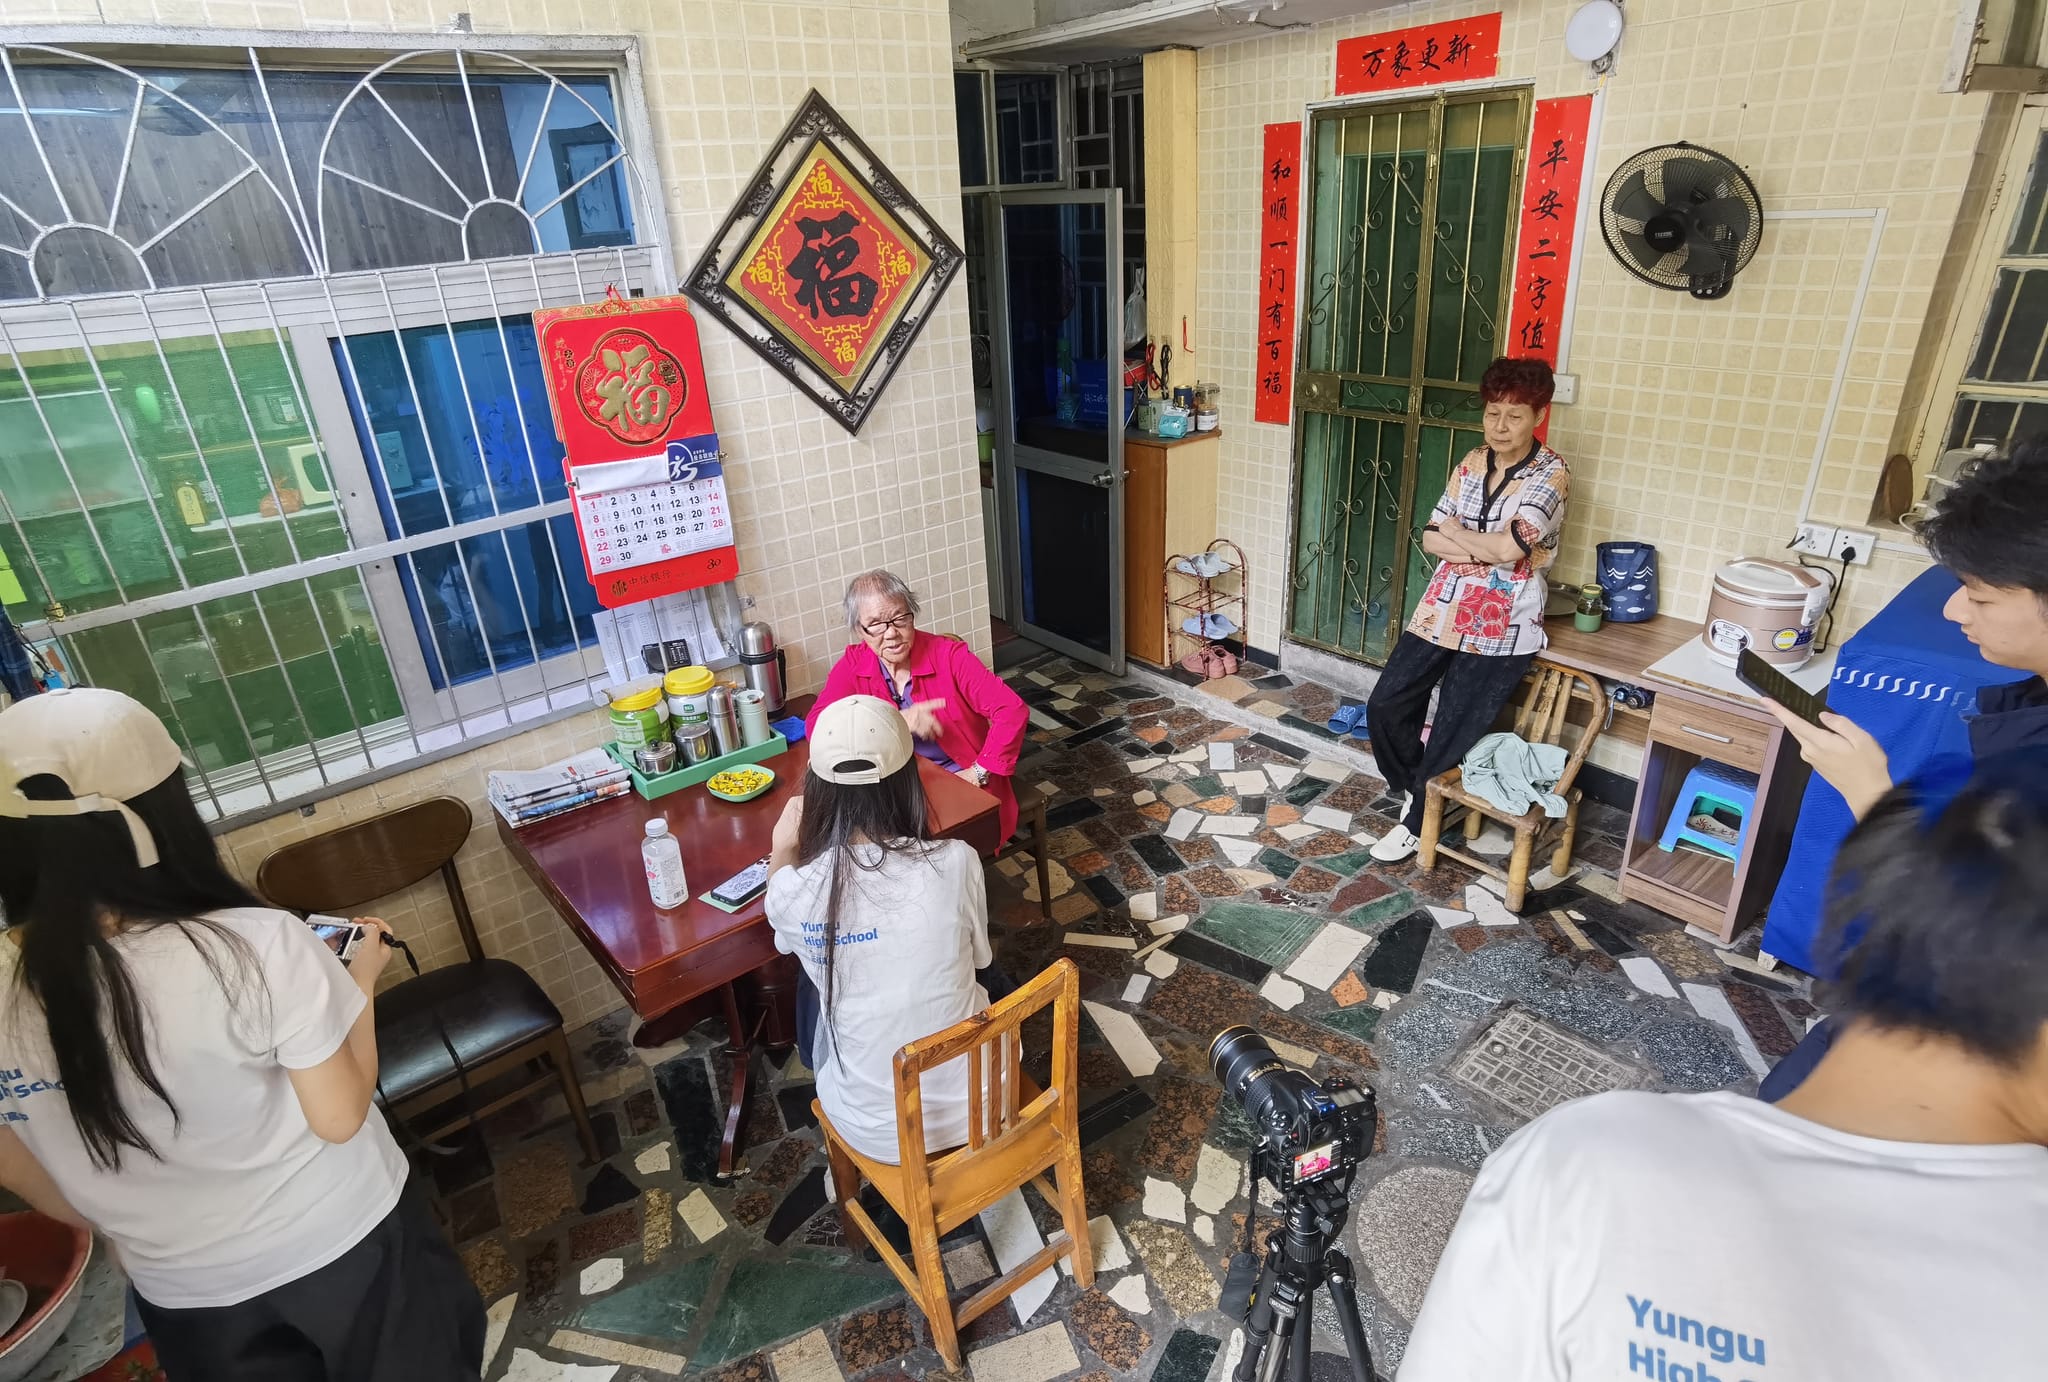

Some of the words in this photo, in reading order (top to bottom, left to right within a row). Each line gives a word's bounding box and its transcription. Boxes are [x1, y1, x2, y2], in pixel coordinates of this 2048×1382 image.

[1362, 34, 1473, 79] 万象更新
[807, 164, 833, 196] 福
[1520, 140, 1568, 351] 平安二字值
[747, 257, 774, 284] 福
[786, 210, 879, 318] 福
[889, 253, 911, 279] 福
[1263, 158, 1291, 395] 和顺一门有百福
[833, 338, 856, 364] 福
[596, 345, 670, 432] 福
[593, 515, 599, 523] 8
[614, 511, 619, 519] 9
[631, 507, 642, 516] 10
[651, 503, 661, 511] 11
[671, 499, 681, 508] 12
[690, 496, 699, 505] 13
[708, 493, 718, 501] 14
[611, 497, 616, 505] 2
[631, 494, 636, 502] 3
[689, 483, 695, 491] 6
[594, 529, 606, 537] 15
[614, 524, 625, 533] 16
[634, 521, 644, 529] 17
[654, 517, 664, 526] 18
[673, 513, 683, 522] 19
[692, 510, 702, 518] 20
[711, 506, 721, 514] 21
[597, 543, 609, 552] 22
[617, 538, 628, 547] 23
[637, 534, 647, 543] 24
[656, 530, 667, 539] 25
[675, 526, 686, 535] 26
[695, 523, 704, 531] 27
[713, 519, 723, 528] 28
[600, 556, 611, 565] 29
[620, 552, 631, 561] 30
[801, 922, 840, 932] Yunu
[804, 936, 828, 948] High
[834, 928, 878, 945] School
[1626, 1294, 1766, 1366] Yungu
